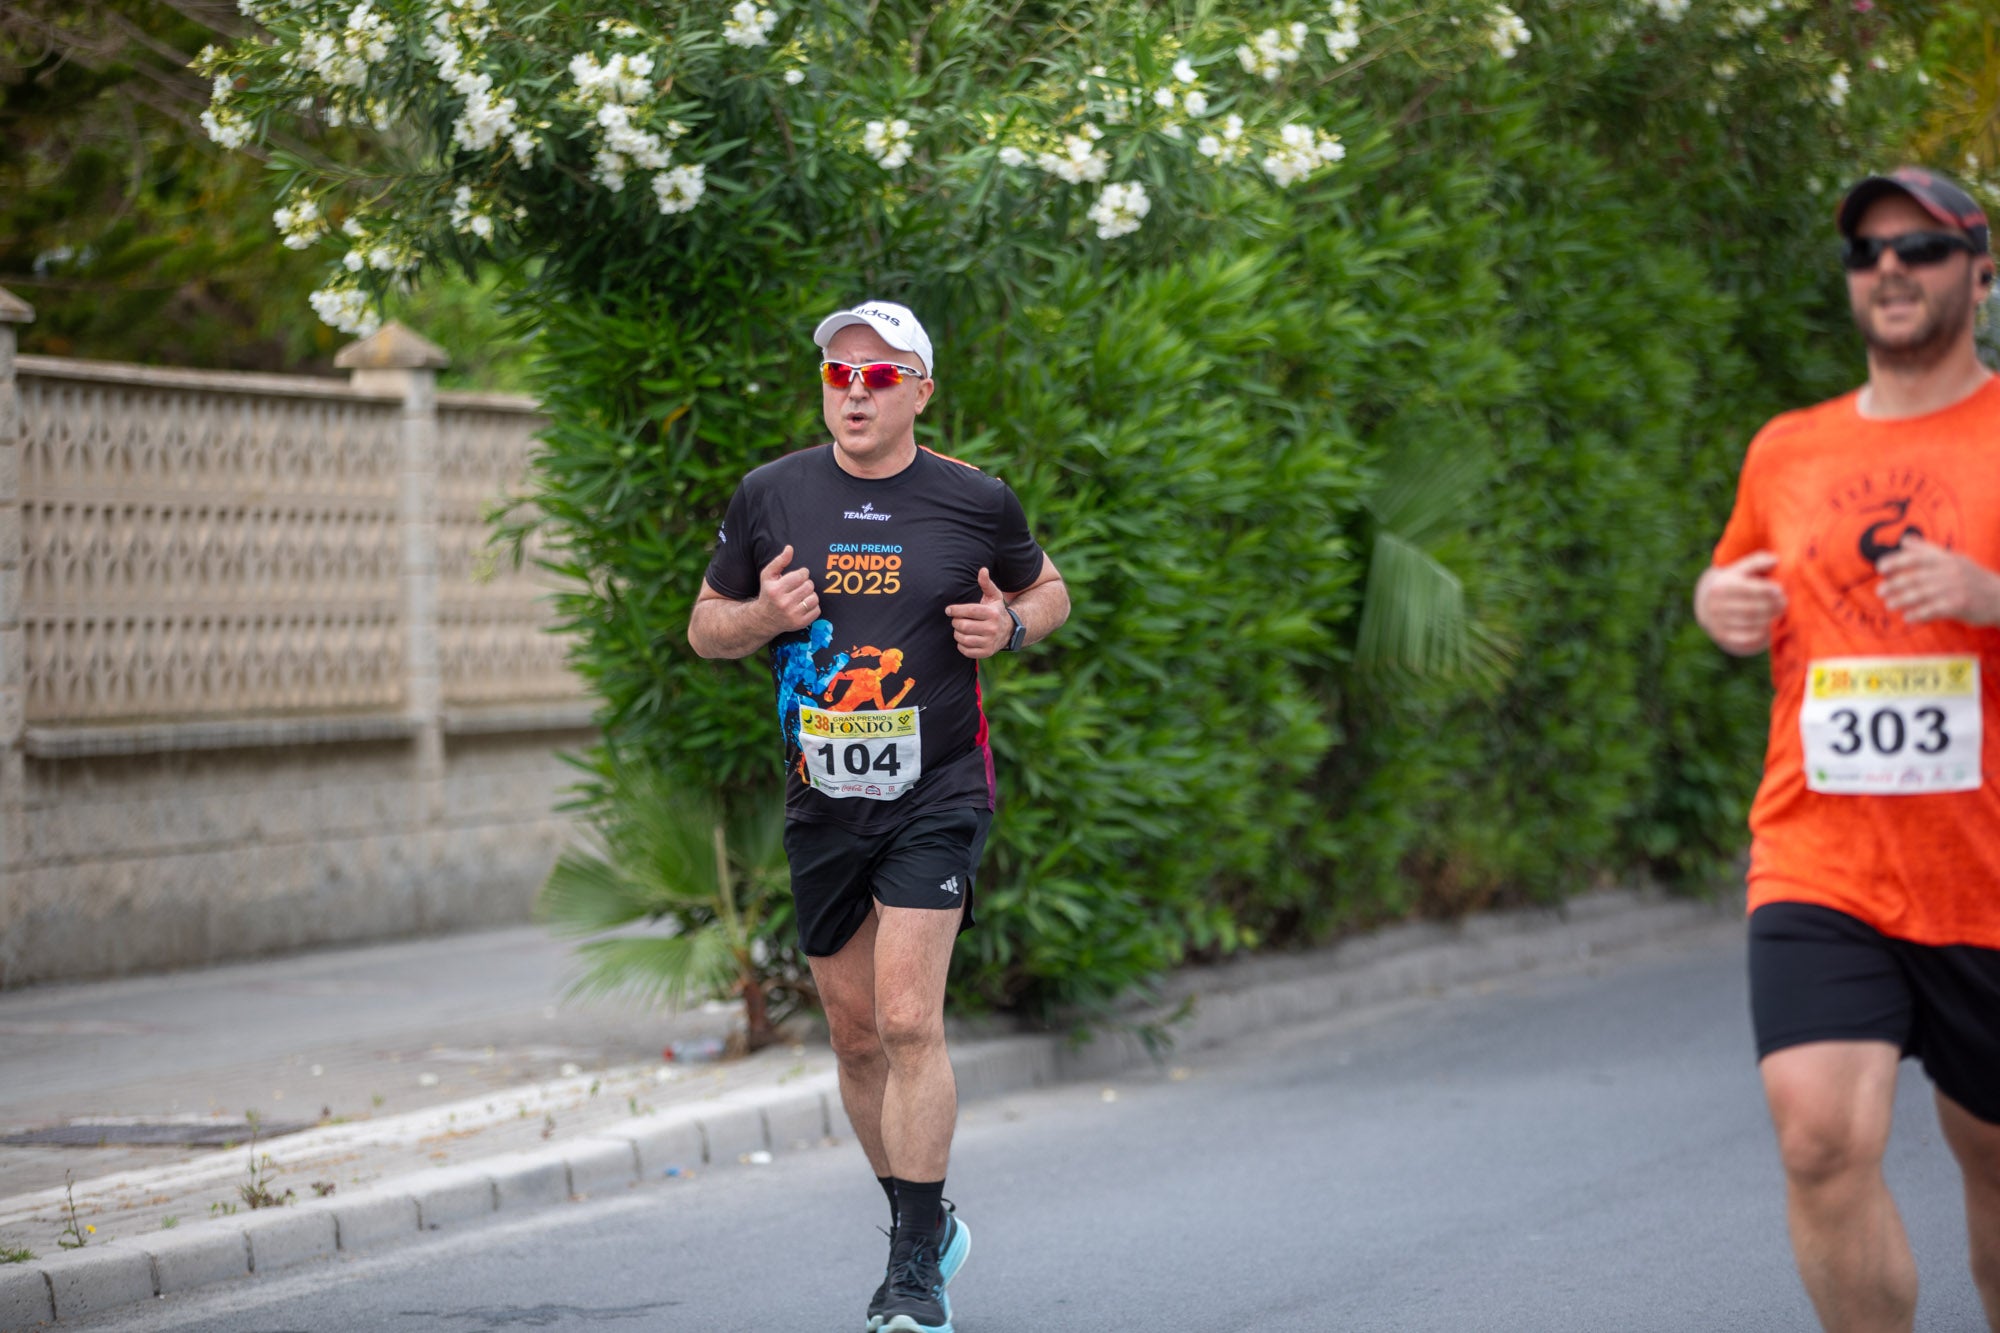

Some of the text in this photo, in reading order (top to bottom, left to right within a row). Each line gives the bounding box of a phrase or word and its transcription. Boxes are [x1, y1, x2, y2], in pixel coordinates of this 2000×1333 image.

[843, 511, 892, 521] TEAMERGY
[829, 543, 903, 554] GRAN PREMIO
[826, 554, 902, 571] FONDO
[823, 570, 901, 595] 2025
[814, 714, 894, 734] 38 FONDO
[1831, 708, 1951, 756] 303
[817, 742, 902, 777] 104
